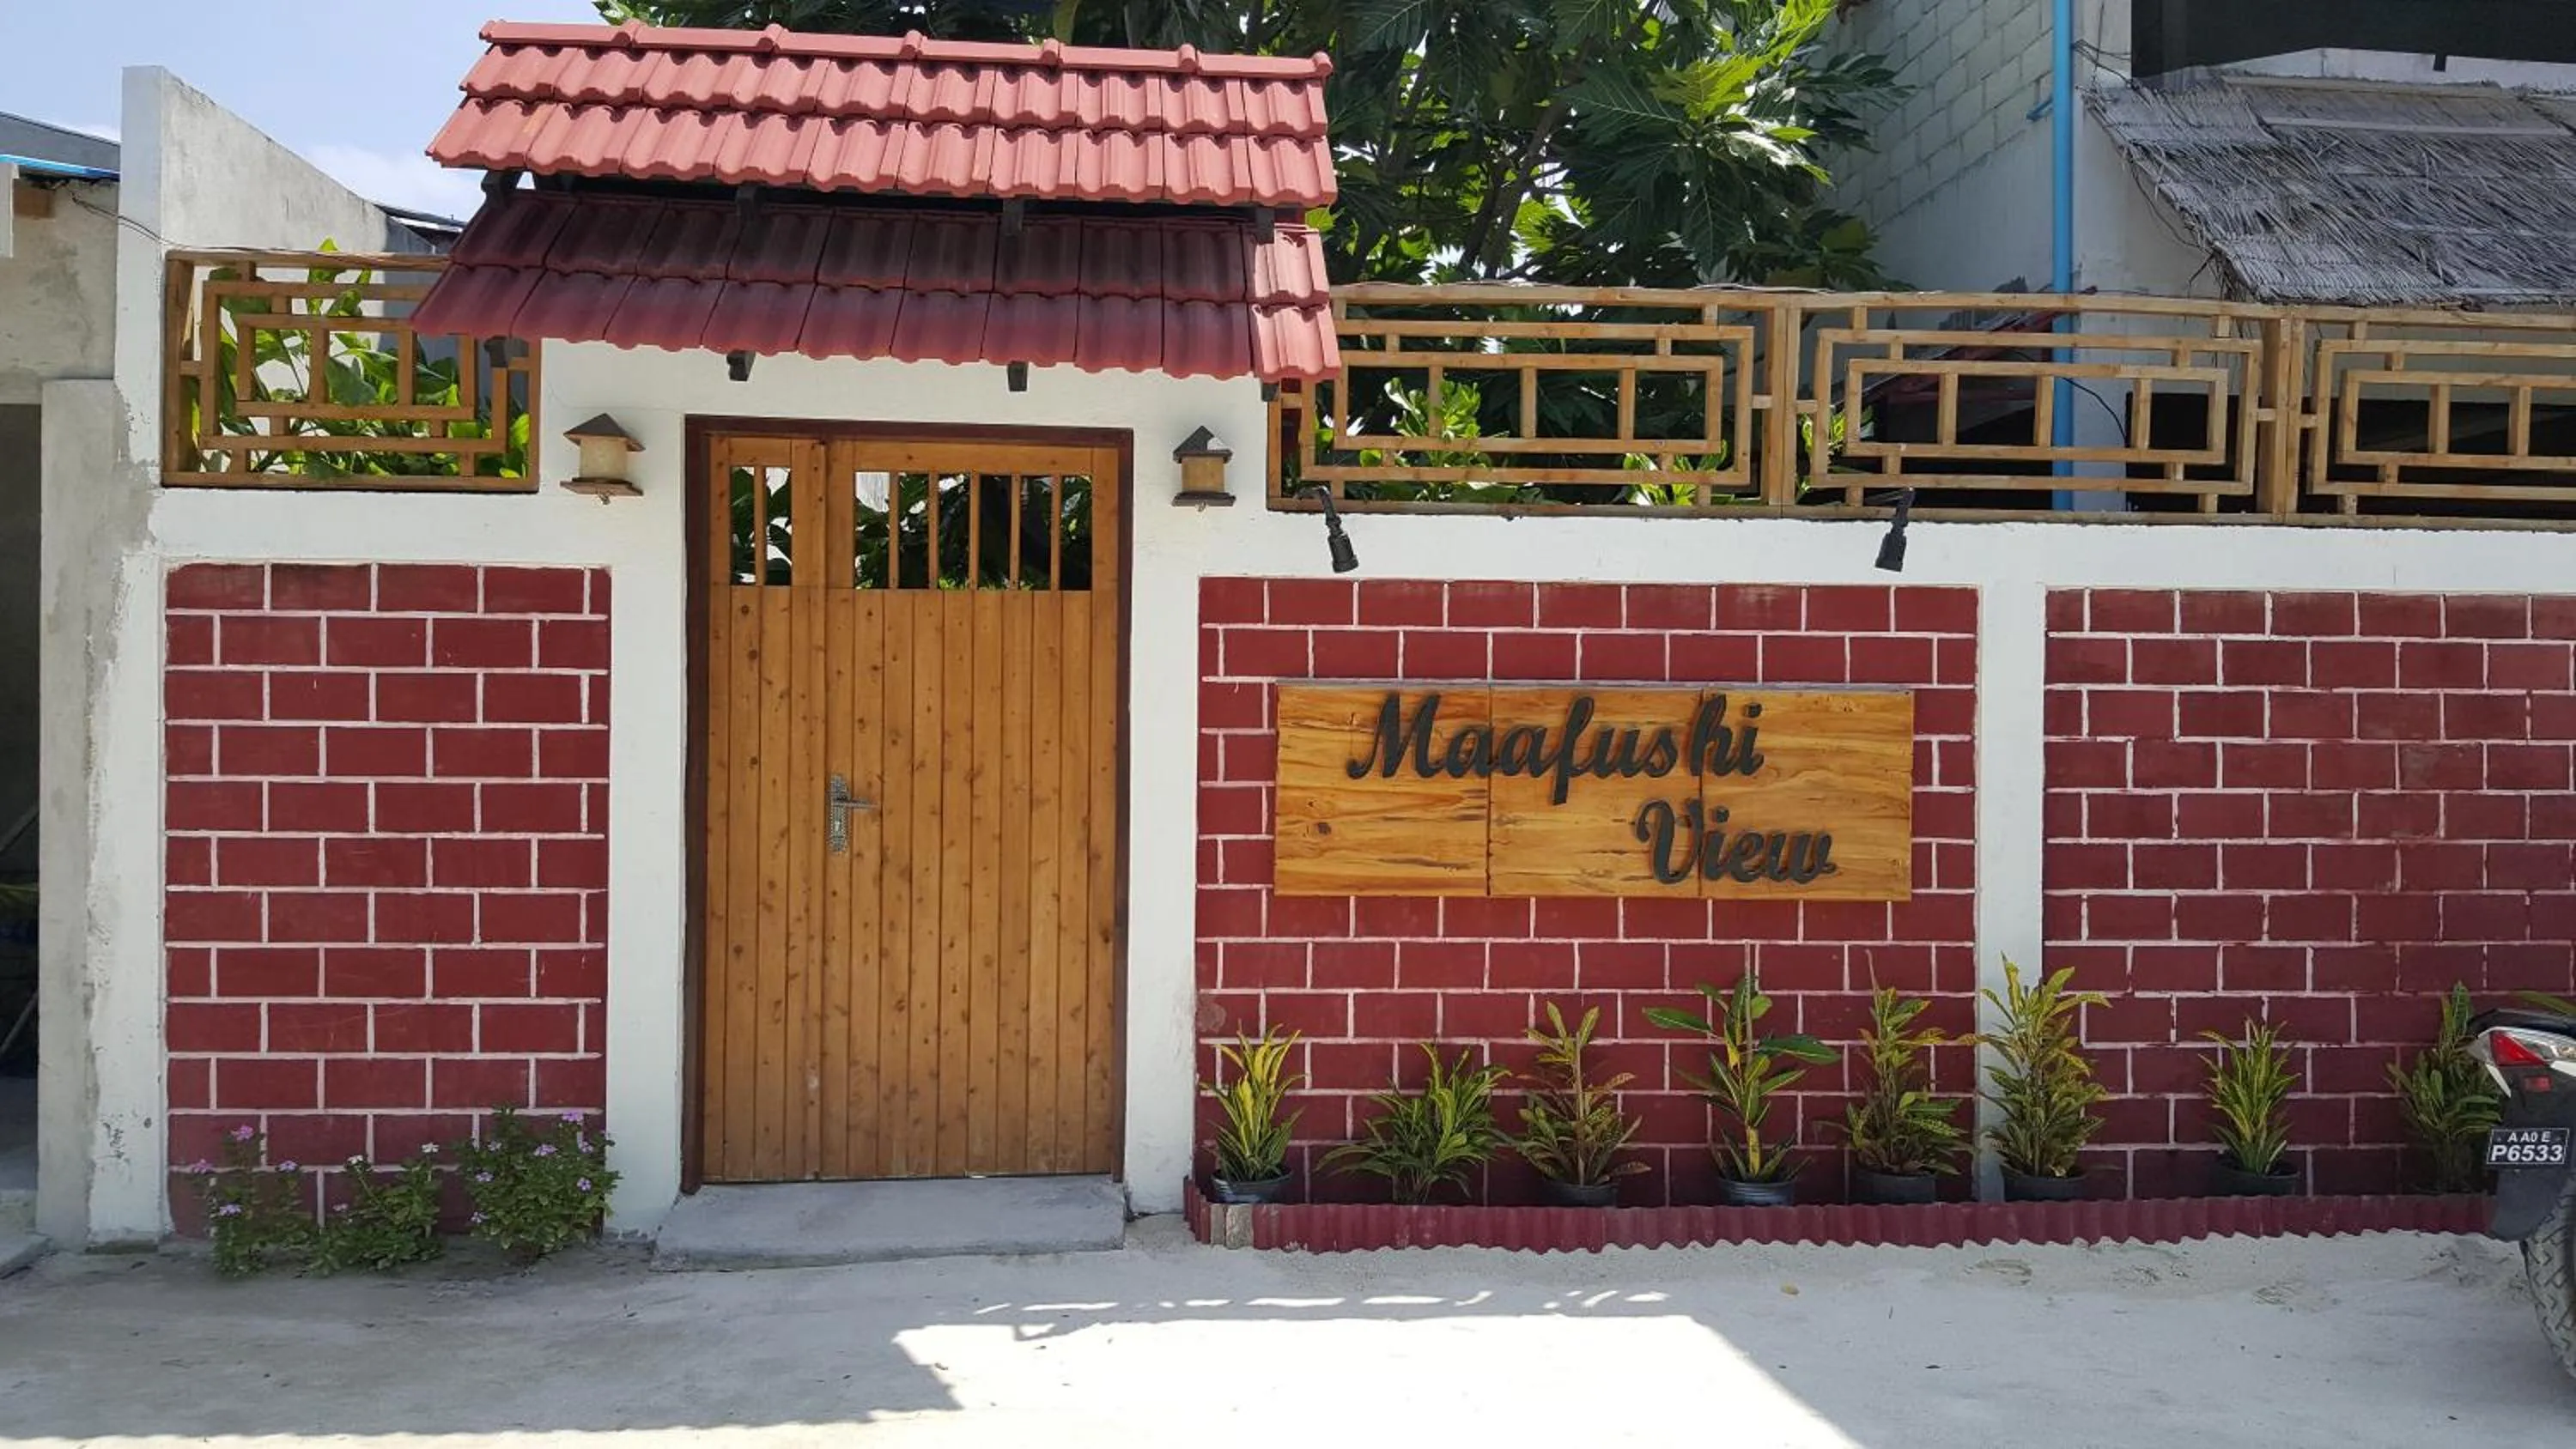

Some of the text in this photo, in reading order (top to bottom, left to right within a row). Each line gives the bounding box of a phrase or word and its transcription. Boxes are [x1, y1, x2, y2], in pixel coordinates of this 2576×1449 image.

[1346, 693, 1764, 805] Maafushi
[1637, 798, 1837, 884] View
[2491, 1144, 2563, 1161] P6533
